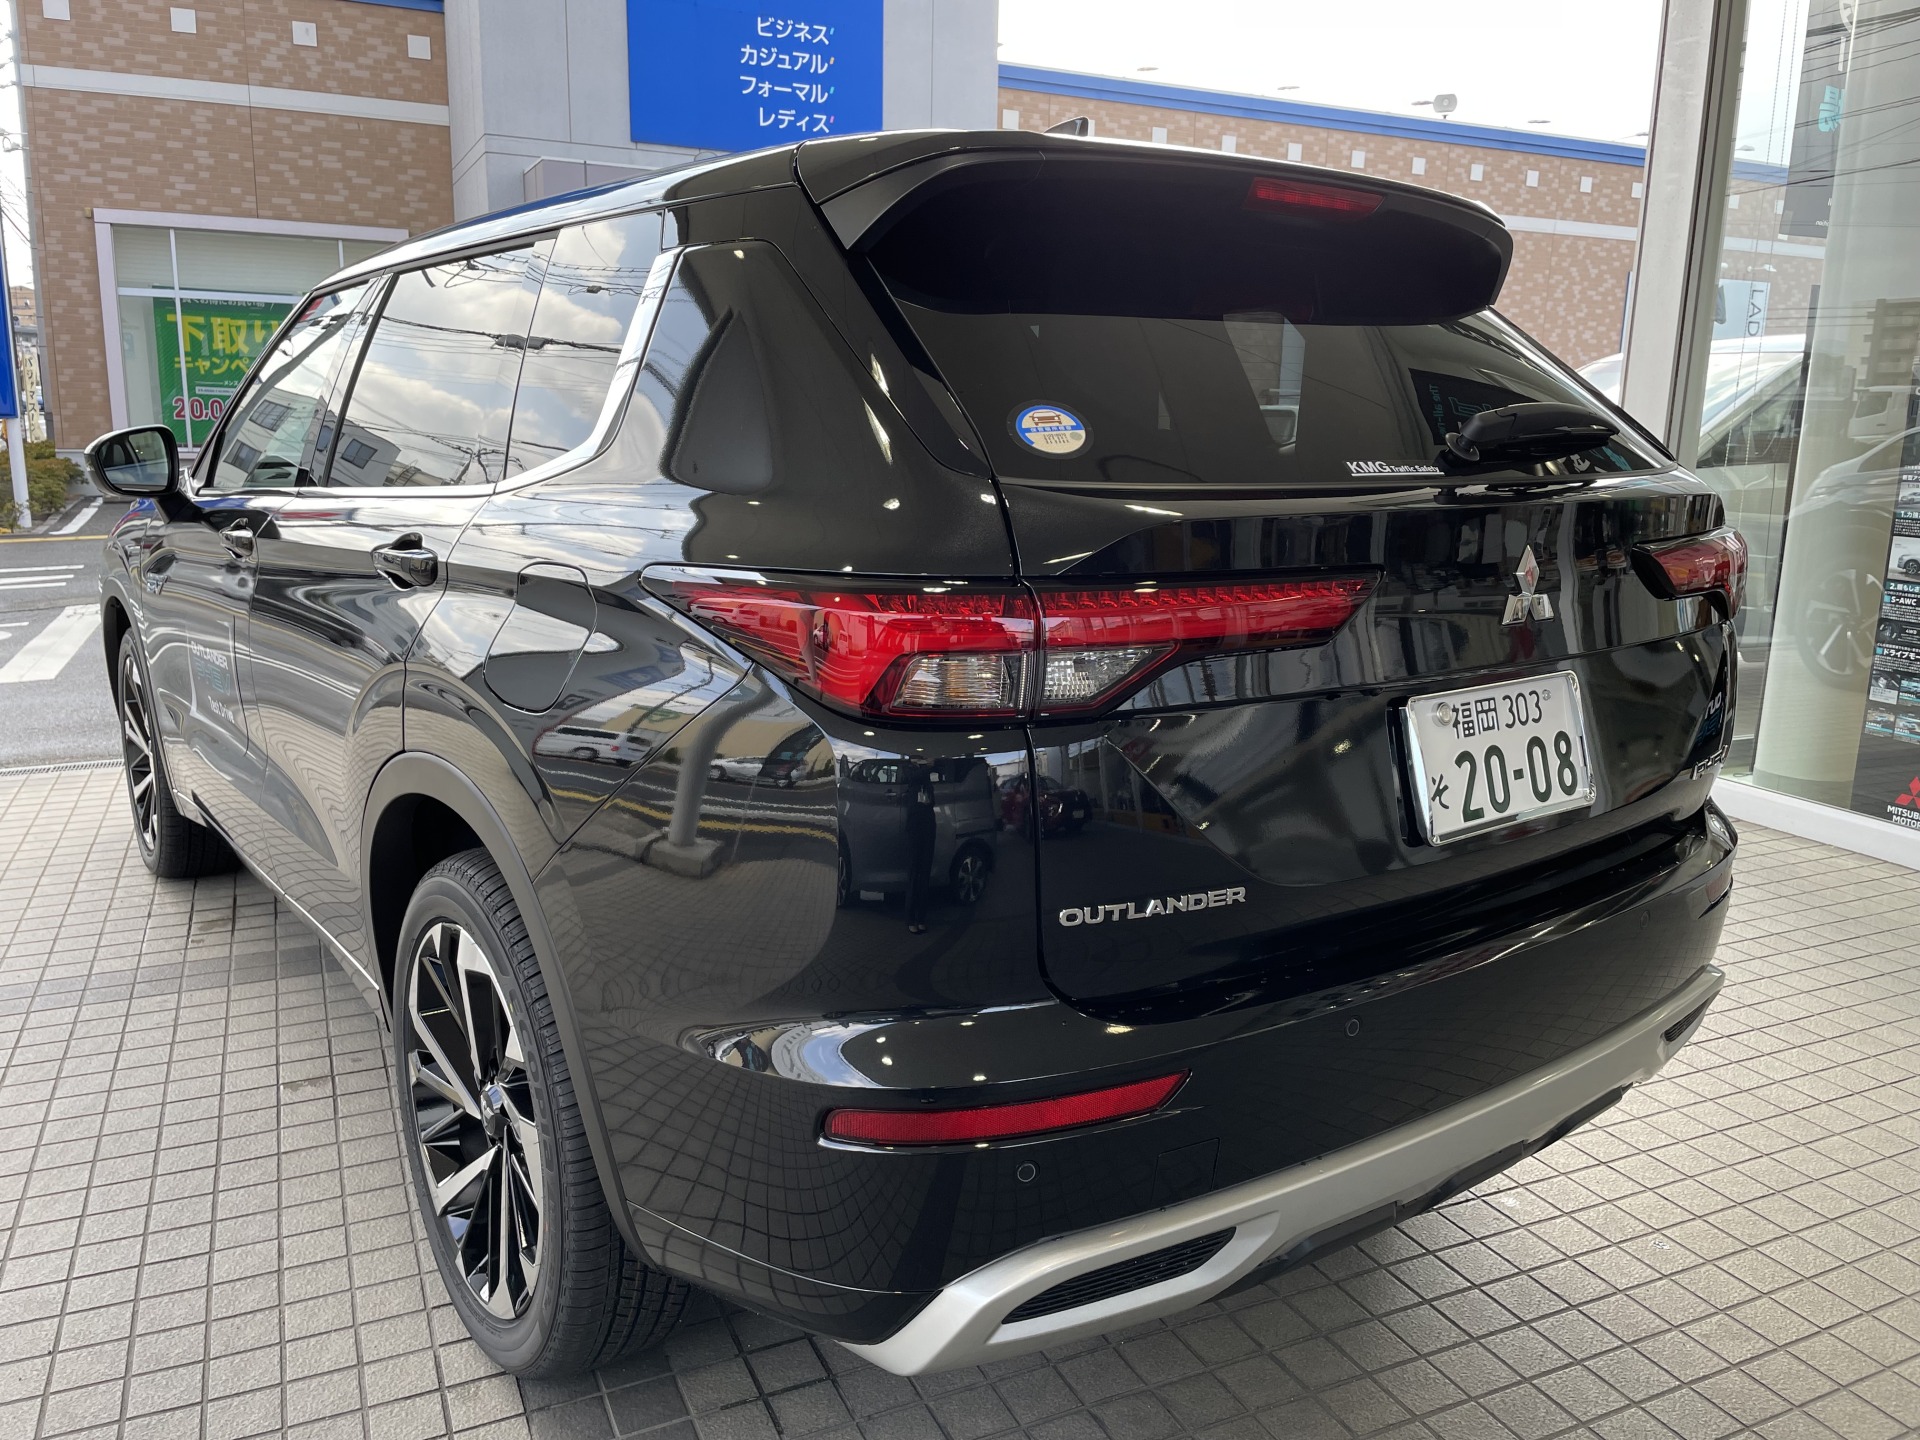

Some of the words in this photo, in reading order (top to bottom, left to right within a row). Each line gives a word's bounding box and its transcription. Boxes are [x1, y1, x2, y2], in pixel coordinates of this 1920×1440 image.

[757, 16, 830, 45] ビジネス
[740, 44, 829, 74] カジュアル
[739, 75, 829, 104] フォーマル
[759, 106, 830, 133] レディス
[172, 396, 231, 420] 20,0
[1346, 461, 1391, 474] KMG
[1389, 465, 1416, 473] Traffic
[1415, 465, 1440, 474] Safety
[1890, 595, 1917, 606] S-AWC
[190, 640, 229, 671] OUTLANDER
[1452, 697, 1500, 739] 福岡
[1502, 690, 1543, 729] 303
[1430, 773, 1450, 810] そ
[1454, 730, 1579, 823] 20-08
[1886, 805, 1920, 820] MITSUB
[1058, 886, 1247, 928] OUTLANDER
